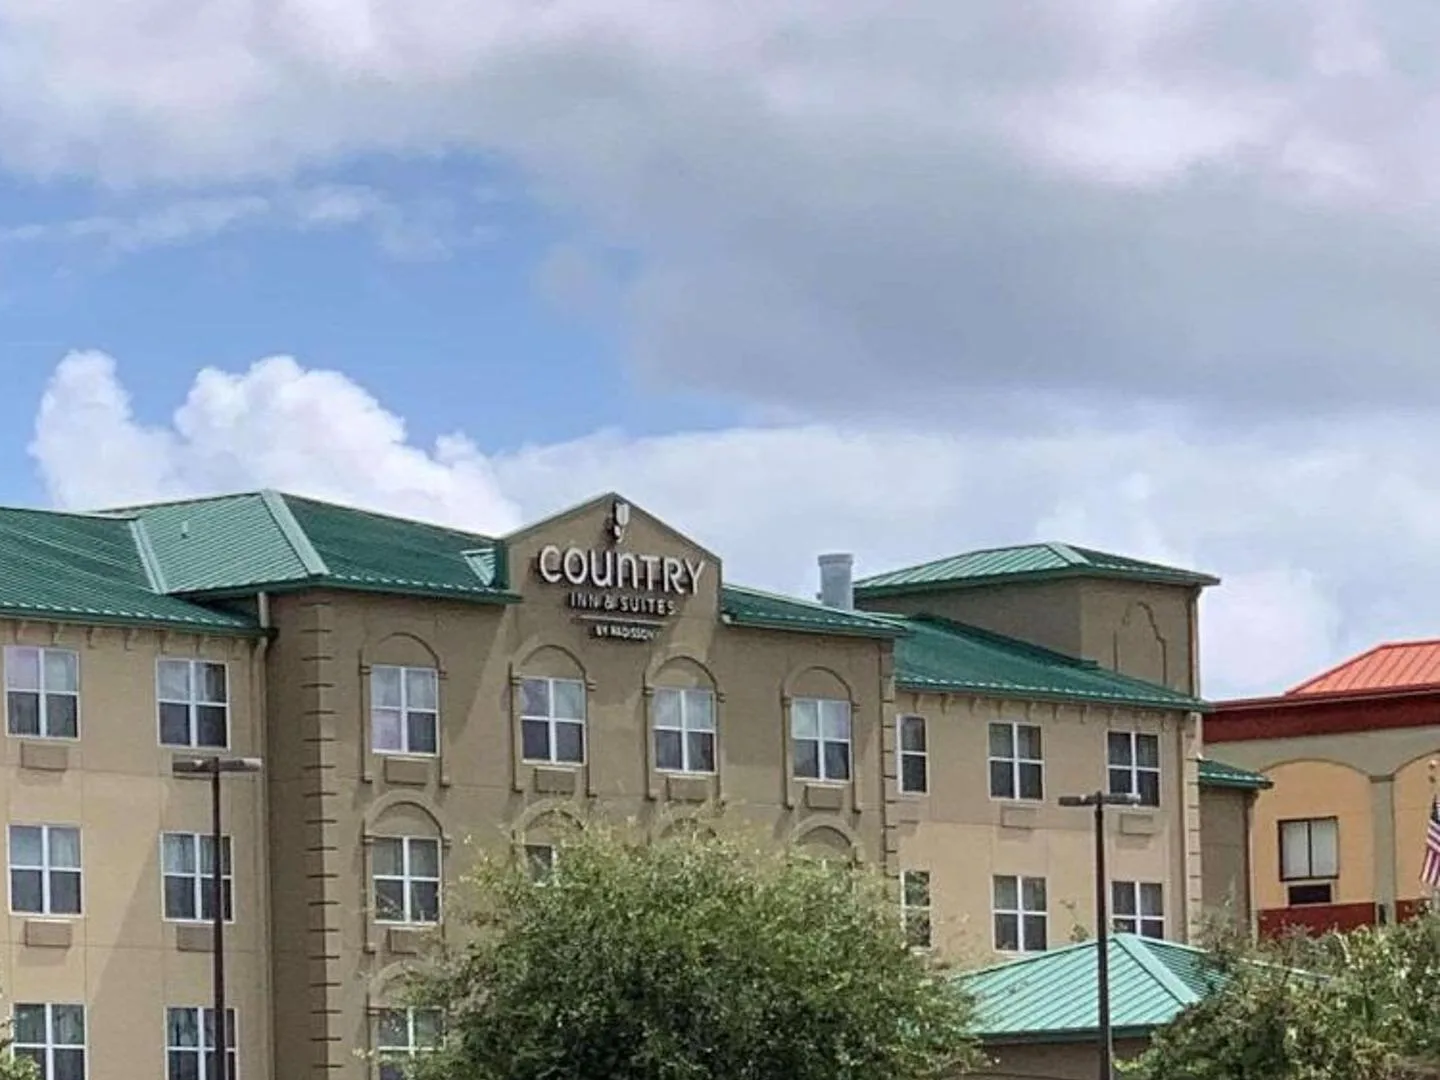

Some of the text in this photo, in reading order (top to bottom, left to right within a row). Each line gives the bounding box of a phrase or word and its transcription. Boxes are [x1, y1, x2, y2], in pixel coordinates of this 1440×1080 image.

[539, 545, 705, 595] COUNTRY
[570, 591, 677, 615] INN & SUITES
